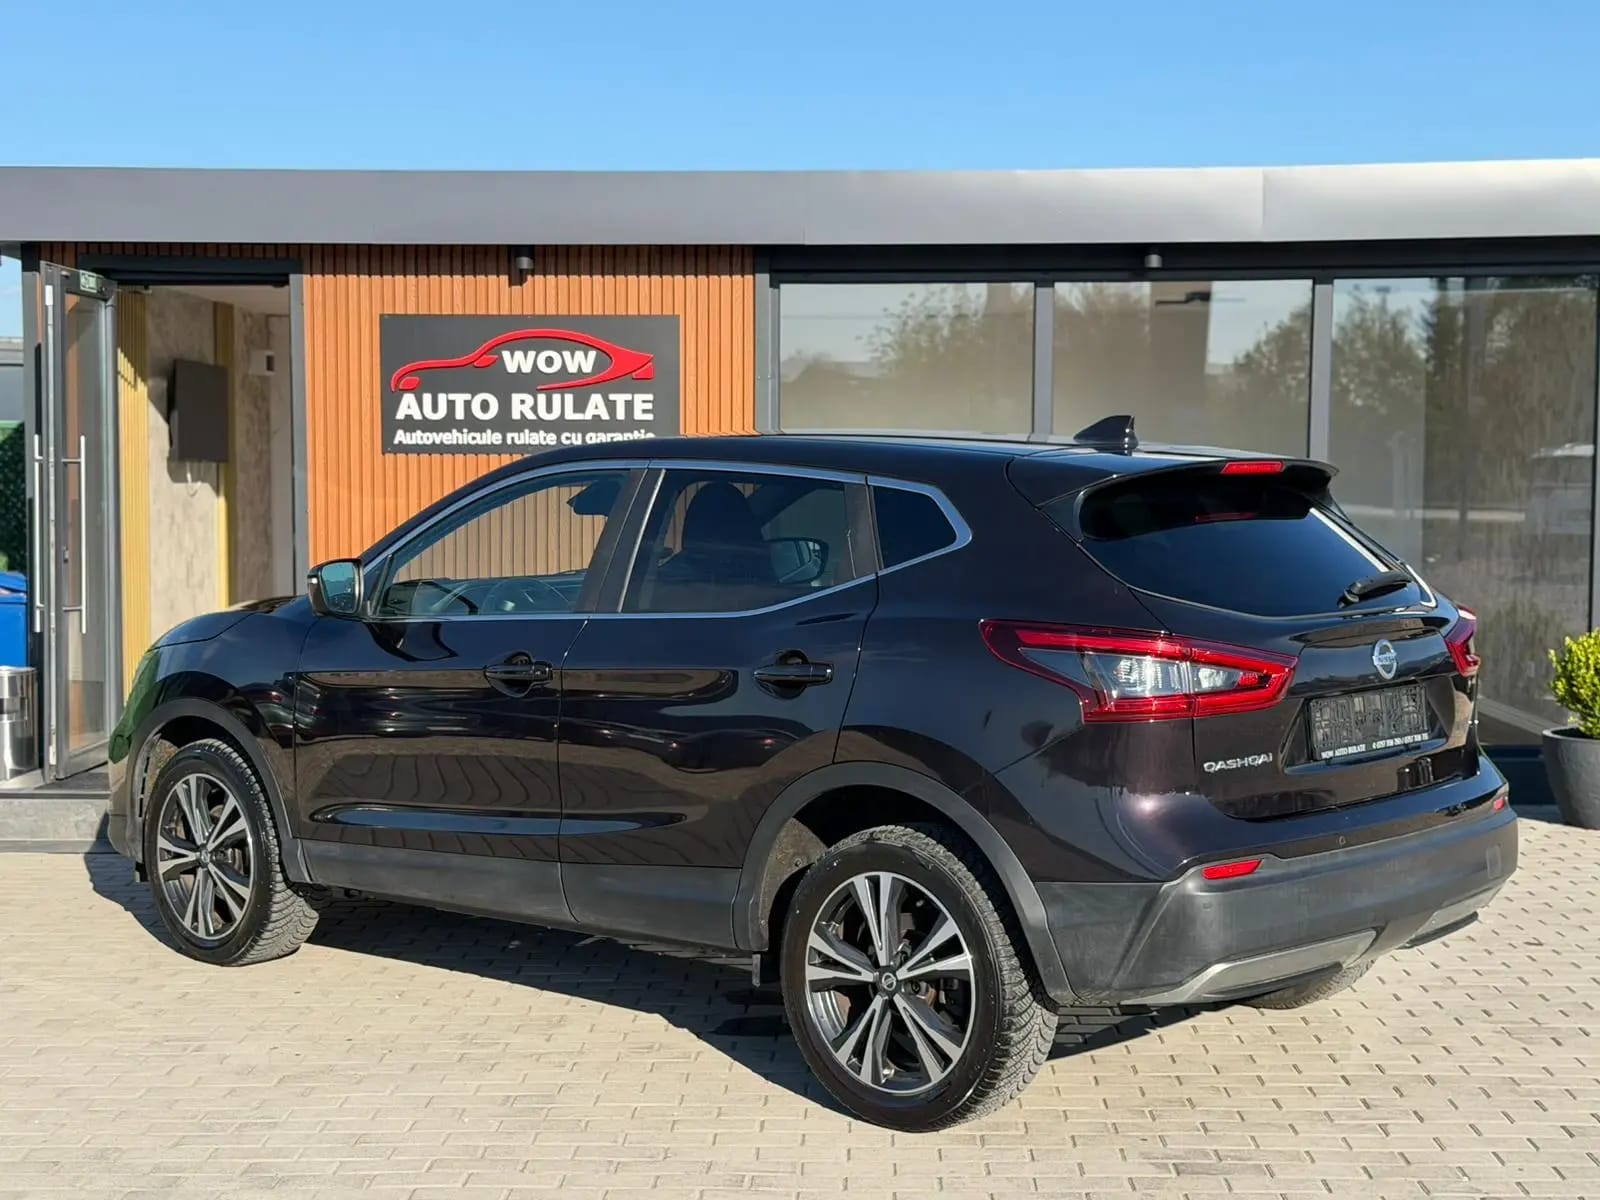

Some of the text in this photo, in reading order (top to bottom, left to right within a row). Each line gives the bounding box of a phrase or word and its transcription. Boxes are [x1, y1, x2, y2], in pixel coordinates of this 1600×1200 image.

[501, 350, 597, 374] WOW
[395, 393, 655, 420] AUTO RULATE
[393, 428, 502, 446] Autovehicule
[506, 429, 557, 445] rulate
[560, 432, 582, 446] cu
[1203, 752, 1273, 773] QASHQAI
